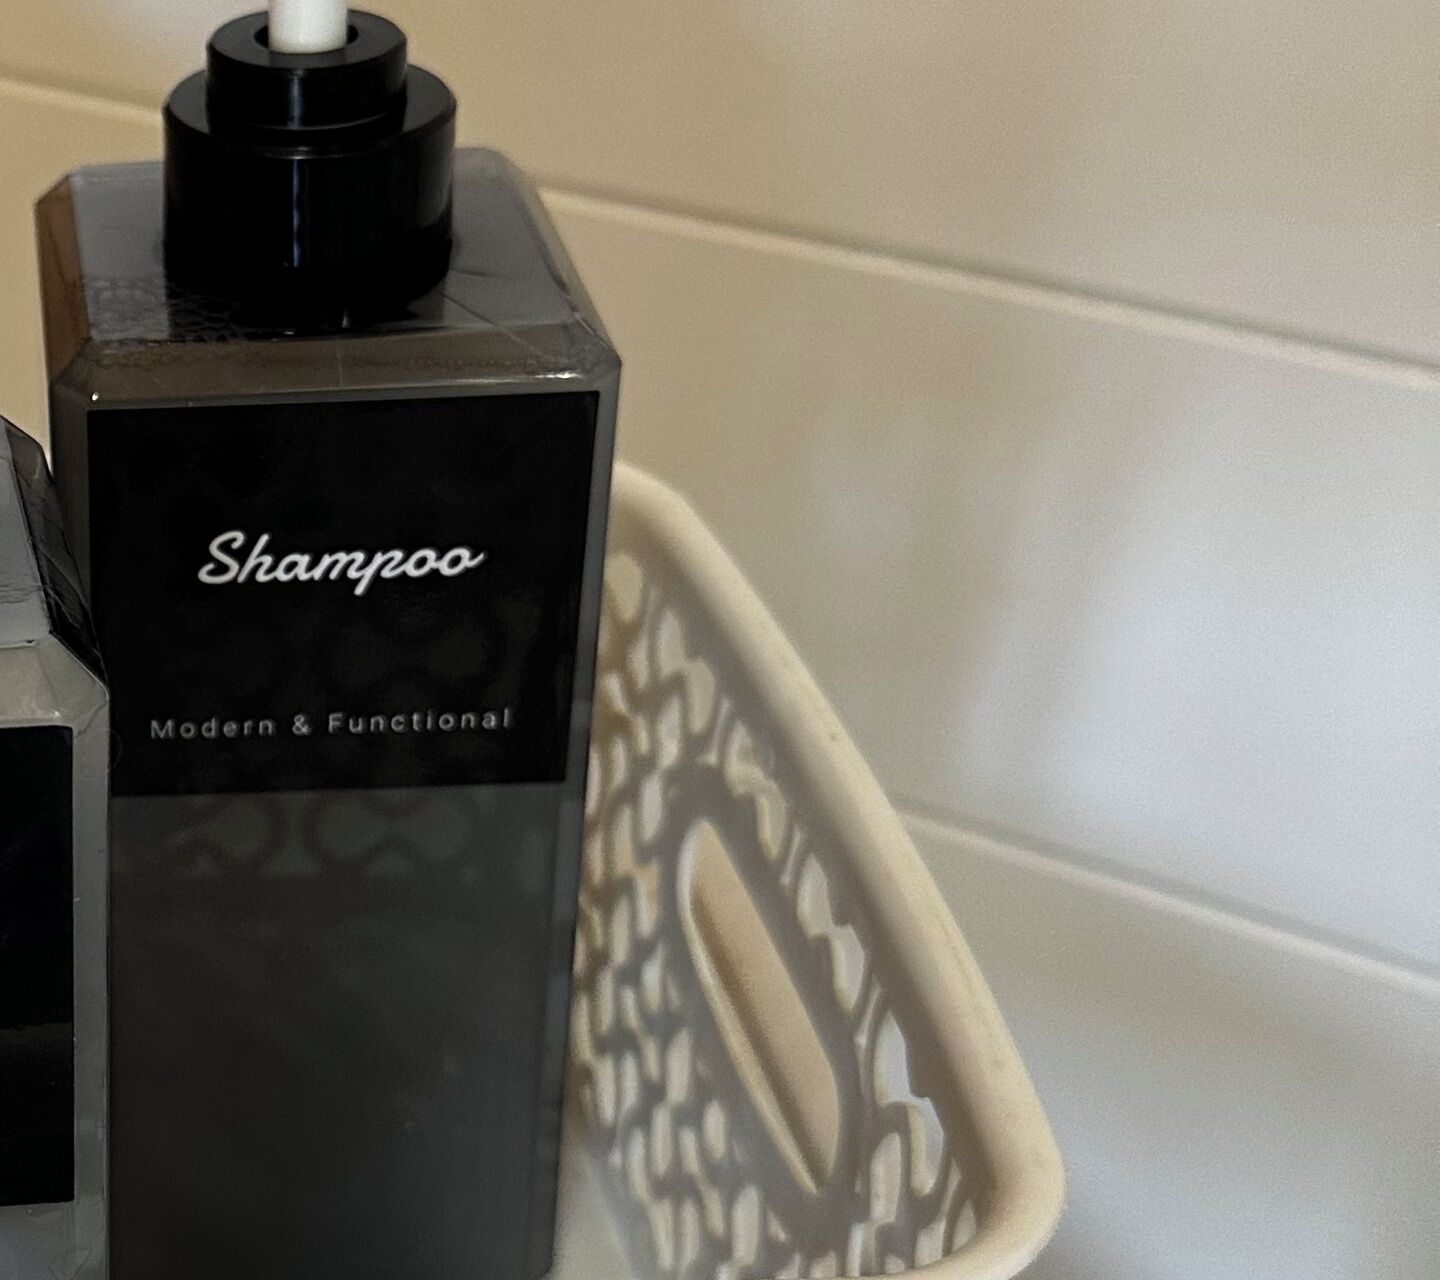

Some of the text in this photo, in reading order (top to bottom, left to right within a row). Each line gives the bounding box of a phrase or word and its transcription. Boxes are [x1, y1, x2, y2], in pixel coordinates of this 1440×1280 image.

[197, 530, 486, 597] Shampoo
[150, 707, 513, 741] Modern & Functional
